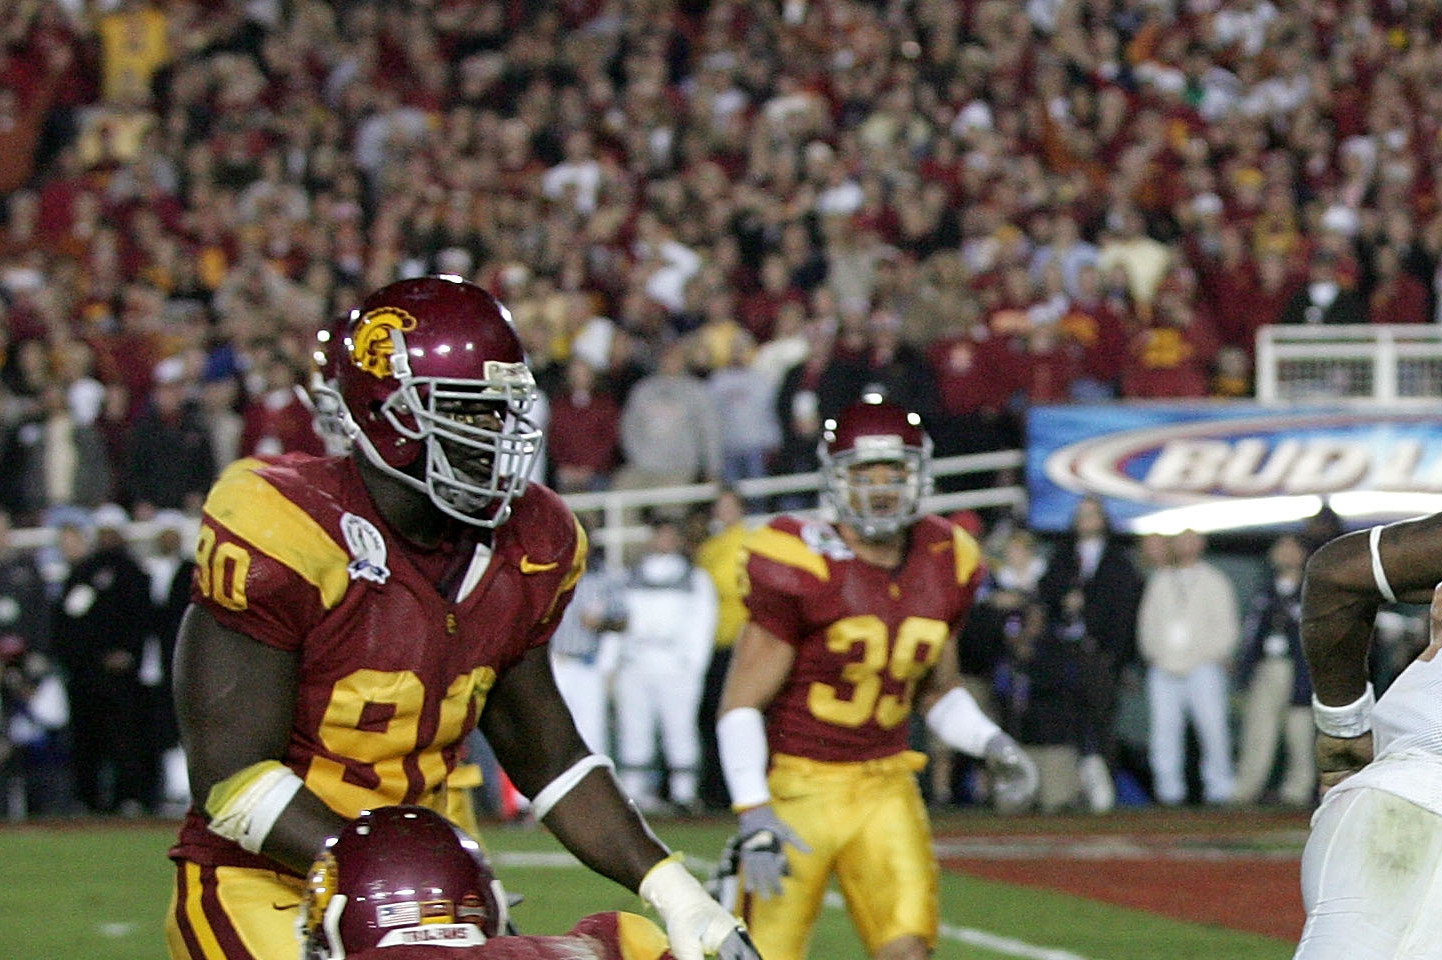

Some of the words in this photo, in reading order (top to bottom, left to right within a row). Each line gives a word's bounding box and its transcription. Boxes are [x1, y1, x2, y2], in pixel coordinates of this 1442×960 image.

[1147, 436, 1368, 494] BUD
[194, 524, 251, 611] 90
[806, 614, 949, 730] 39
